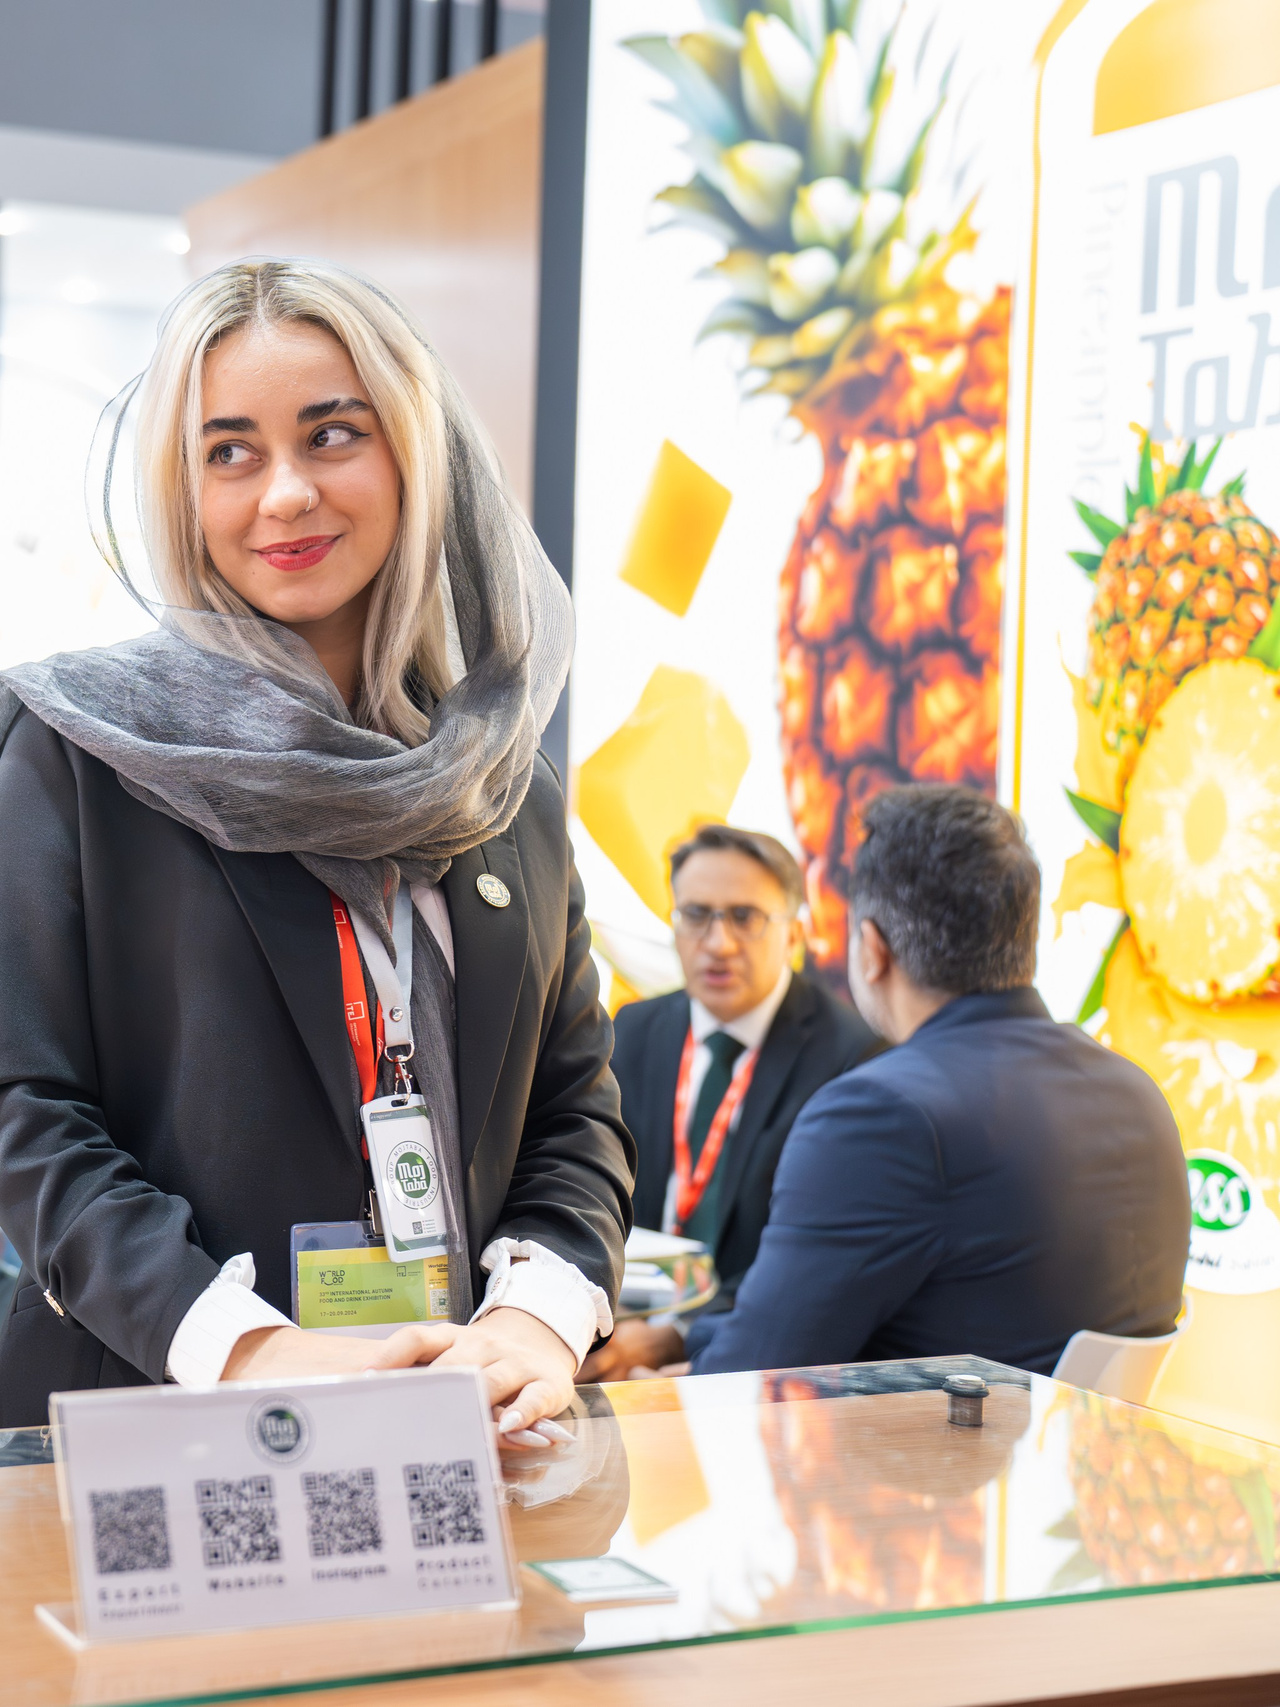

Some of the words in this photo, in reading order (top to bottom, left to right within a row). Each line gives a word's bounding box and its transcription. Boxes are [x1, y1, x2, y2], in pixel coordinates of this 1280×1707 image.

[394, 1144, 422, 1157] MOJTABA
[426, 1156, 437, 1179] FOOD
[397, 1162, 426, 1180] Moj
[400, 1178, 428, 1193] Taba
[416, 1555, 491, 1571] Product
[312, 1564, 387, 1582] Instagram
[208, 1575, 286, 1591] Website
[98, 1583, 181, 1603] Export
